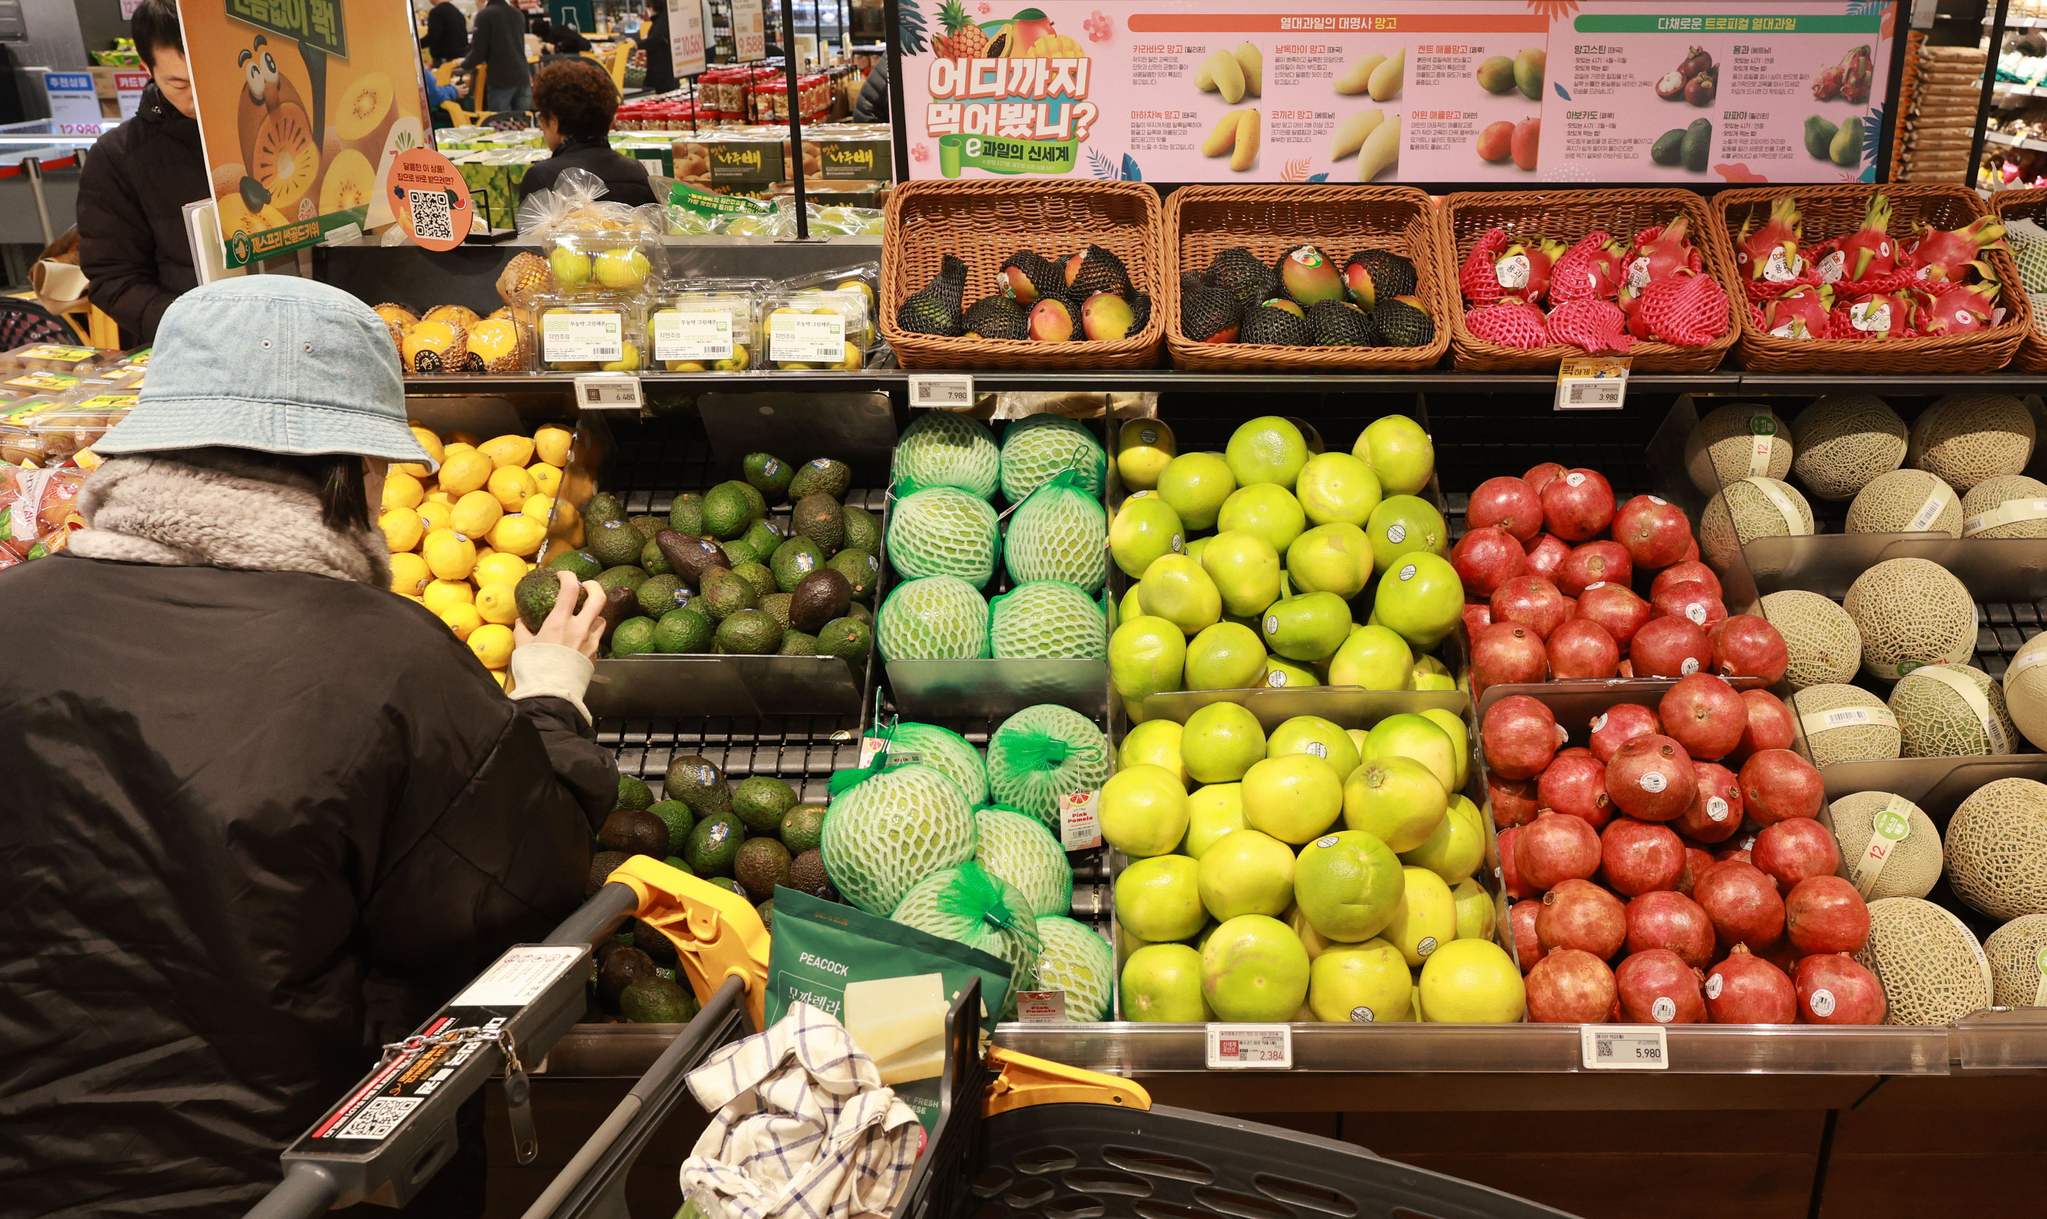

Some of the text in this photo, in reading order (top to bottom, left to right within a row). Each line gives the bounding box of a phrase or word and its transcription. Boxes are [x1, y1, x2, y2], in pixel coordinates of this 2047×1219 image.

[1280, 17, 1397, 30] 열대과일의 대명사 망고
[1658, 18, 1797, 30] 다채로운 트로피컬 열대과일
[738, 35, 764, 55] 9,588
[1133, 45, 1165, 54] 카라바오
[1167, 45, 1183, 54] 망고
[1276, 45, 1308, 54] 남독마이
[1310, 45, 1326, 54] 망고
[1418, 46, 1434, 54] 켄트
[1436, 46, 1468, 54] 애플망고
[1574, 46, 1606, 54] 망고스틴
[1733, 46, 1749, 54] 용과
[929, 58, 1091, 99] 어디까지
[1131, 111, 1162, 120] 마하차녹
[1164, 111, 1180, 120] 망고
[1272, 111, 1294, 120] 코끼리
[1297, 111, 1312, 120] 망고
[1412, 111, 1427, 120] 어윈
[1430, 111, 1461, 120] 애플망고
[1566, 111, 1598, 120] 아보카도
[1724, 111, 1748, 120] 파파야
[927, 102, 1098, 142] 먹어봤니?
[1028, 146, 1069, 162] 신세계
[422, 164, 430, 172] 이
[416, 174, 428, 183] 바로
[251, 231, 283, 253] 제스프리
[284, 221, 320, 246] 썬골드키위
[616, 393, 636, 401] 6.480
[1757, 444, 1768, 456] 12
[1870, 845, 1887, 860] 12
[799, 952, 850, 978] PEACOCK
[1260, 1050, 1284, 1060] 2.384
[1636, 1048, 1660, 1058] 5.980
[914, 1096, 939, 1108] FRESH
